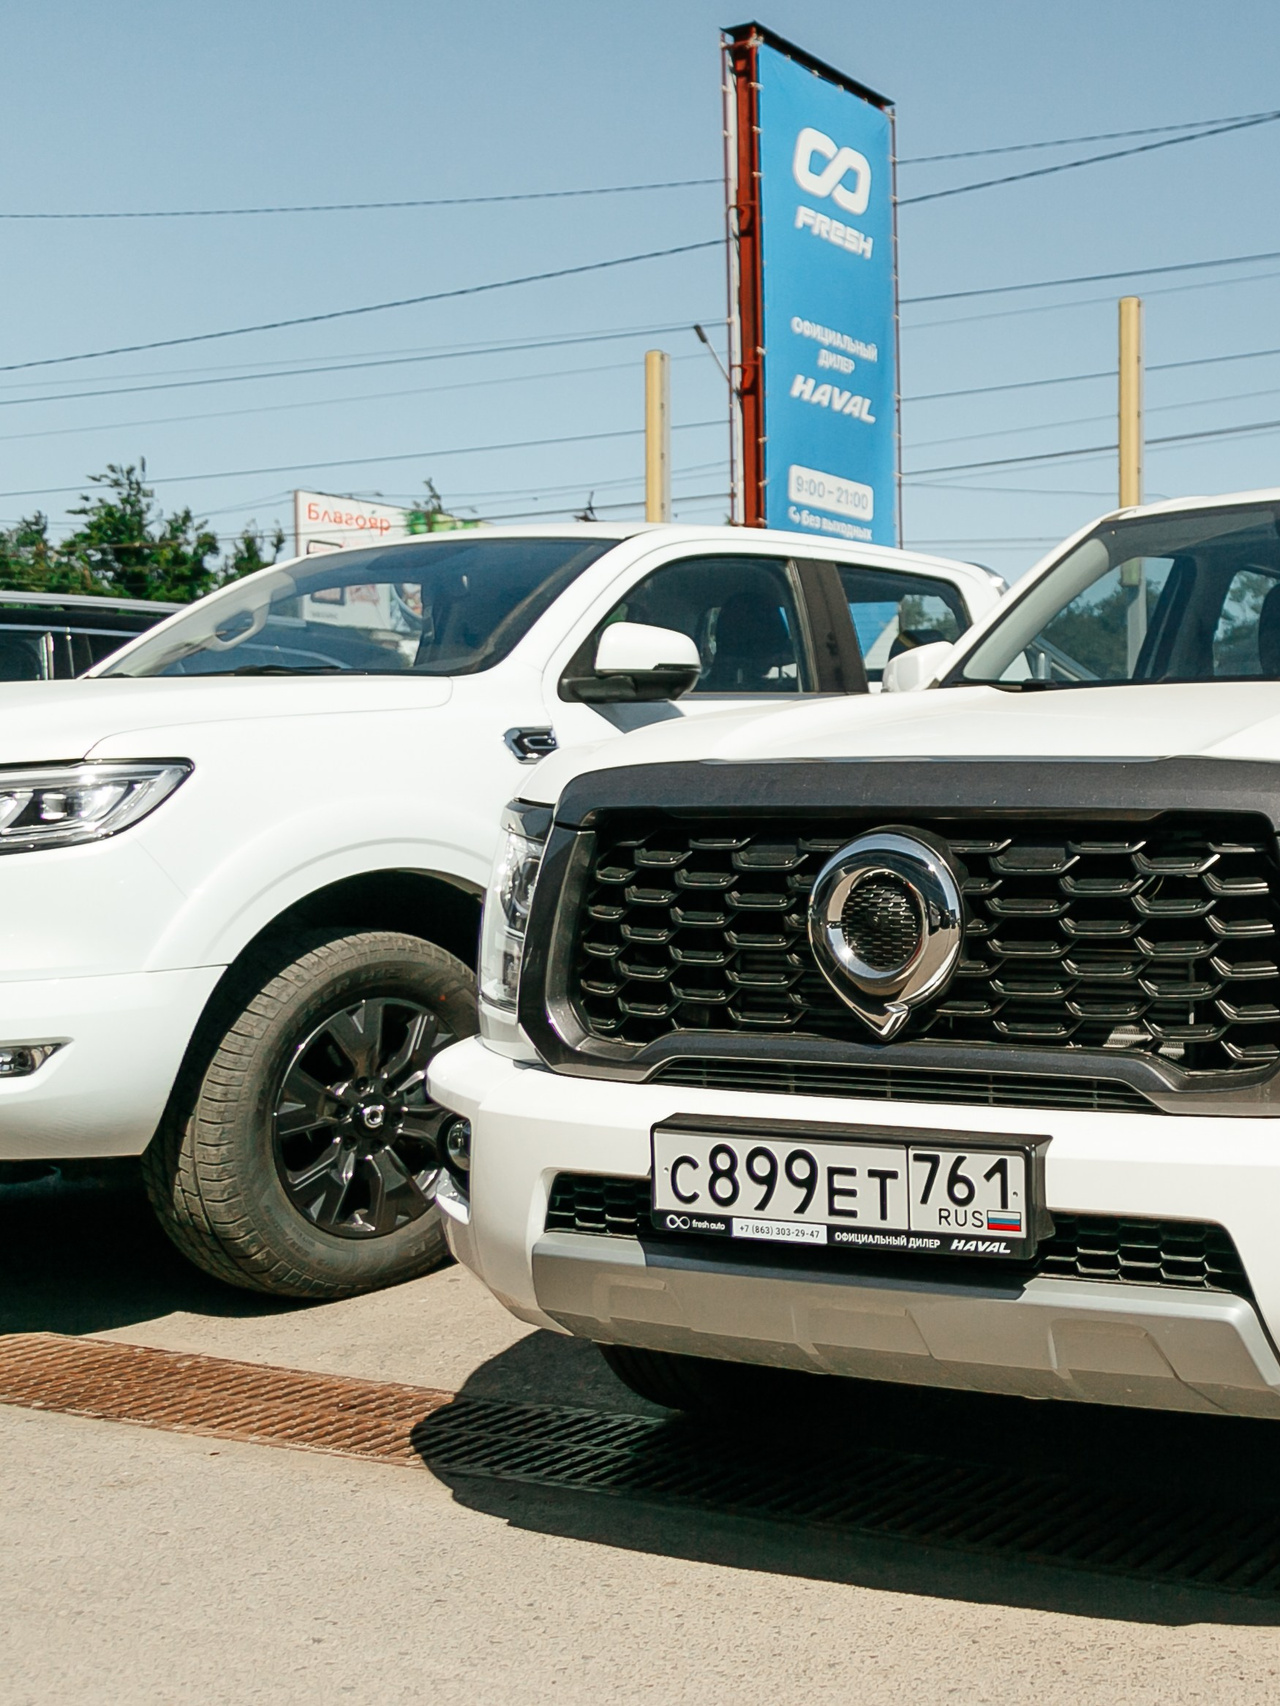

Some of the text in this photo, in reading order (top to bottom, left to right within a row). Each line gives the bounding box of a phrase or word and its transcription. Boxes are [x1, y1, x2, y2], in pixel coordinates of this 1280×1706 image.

[794, 205, 874, 259] FRESH
[790, 316, 878, 363] ОФИЦИАЛЬНЫЙ
[817, 349, 856, 375] ДИЛЕР
[790, 374, 877, 424] HAVAL
[912, 1153, 1009, 1210] 761
[692, 1218, 726, 1230] fresh auto
[938, 1208, 984, 1228] RUS
[739, 1224, 820, 1239] +7 (863) 303-29-47
[834, 1231, 941, 1249] ОФИЦИАЛЬНЫЙ ДИЛЕР
[950, 1238, 1012, 1254] HAVAL
